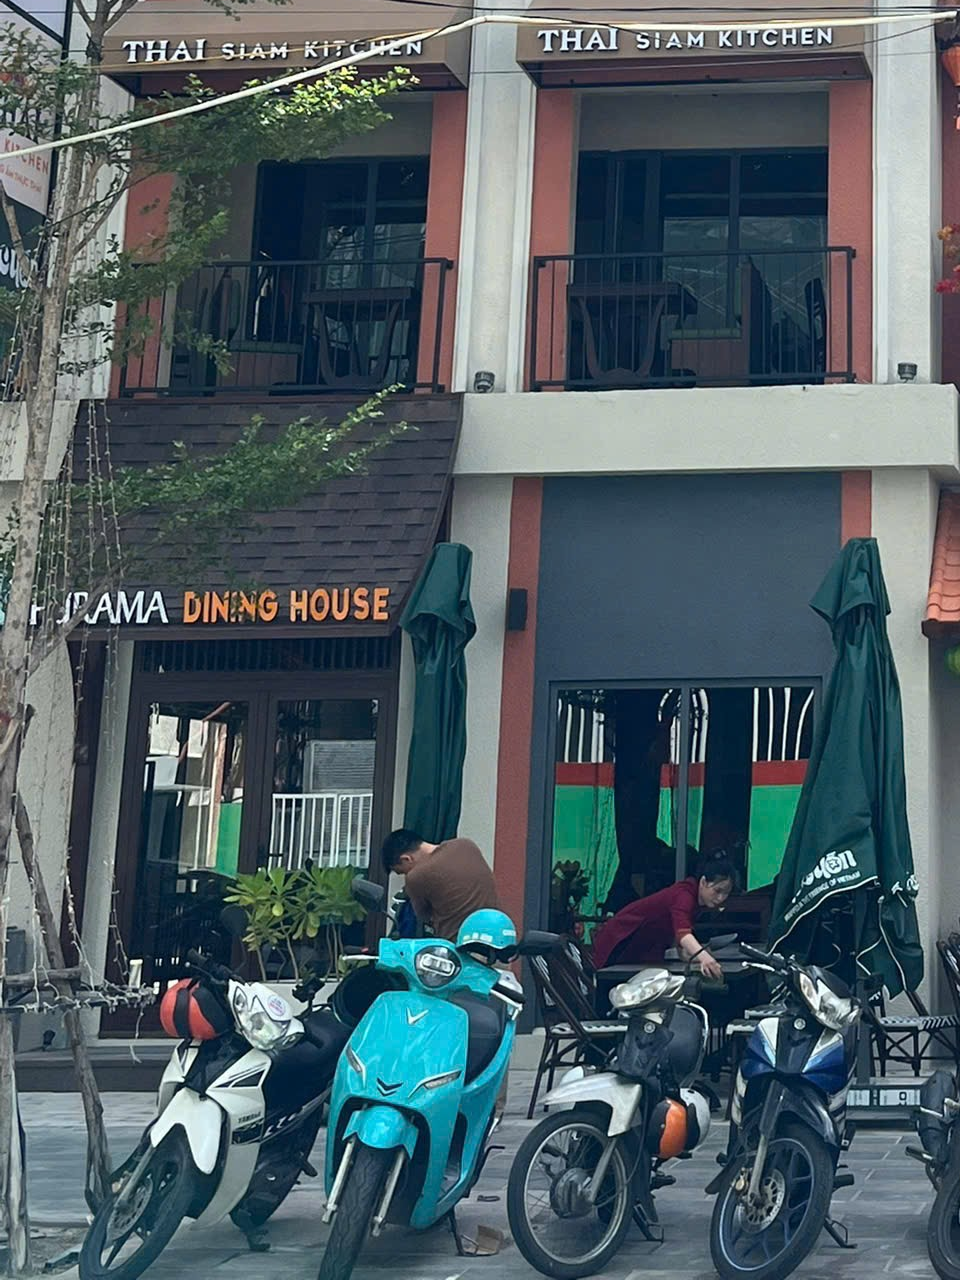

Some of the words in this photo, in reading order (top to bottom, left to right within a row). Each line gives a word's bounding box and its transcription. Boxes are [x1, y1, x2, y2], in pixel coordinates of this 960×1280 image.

[123, 38, 207, 63] THAI
[221, 41, 288, 61] SIAM
[304, 39, 424, 58] KITCHEN
[537, 28, 620, 52] THAI
[636, 31, 705, 50] SIAM
[719, 27, 834, 47] KITCHEN
[183, 590, 278, 623] DINING
[290, 587, 390, 621] HOUSE
